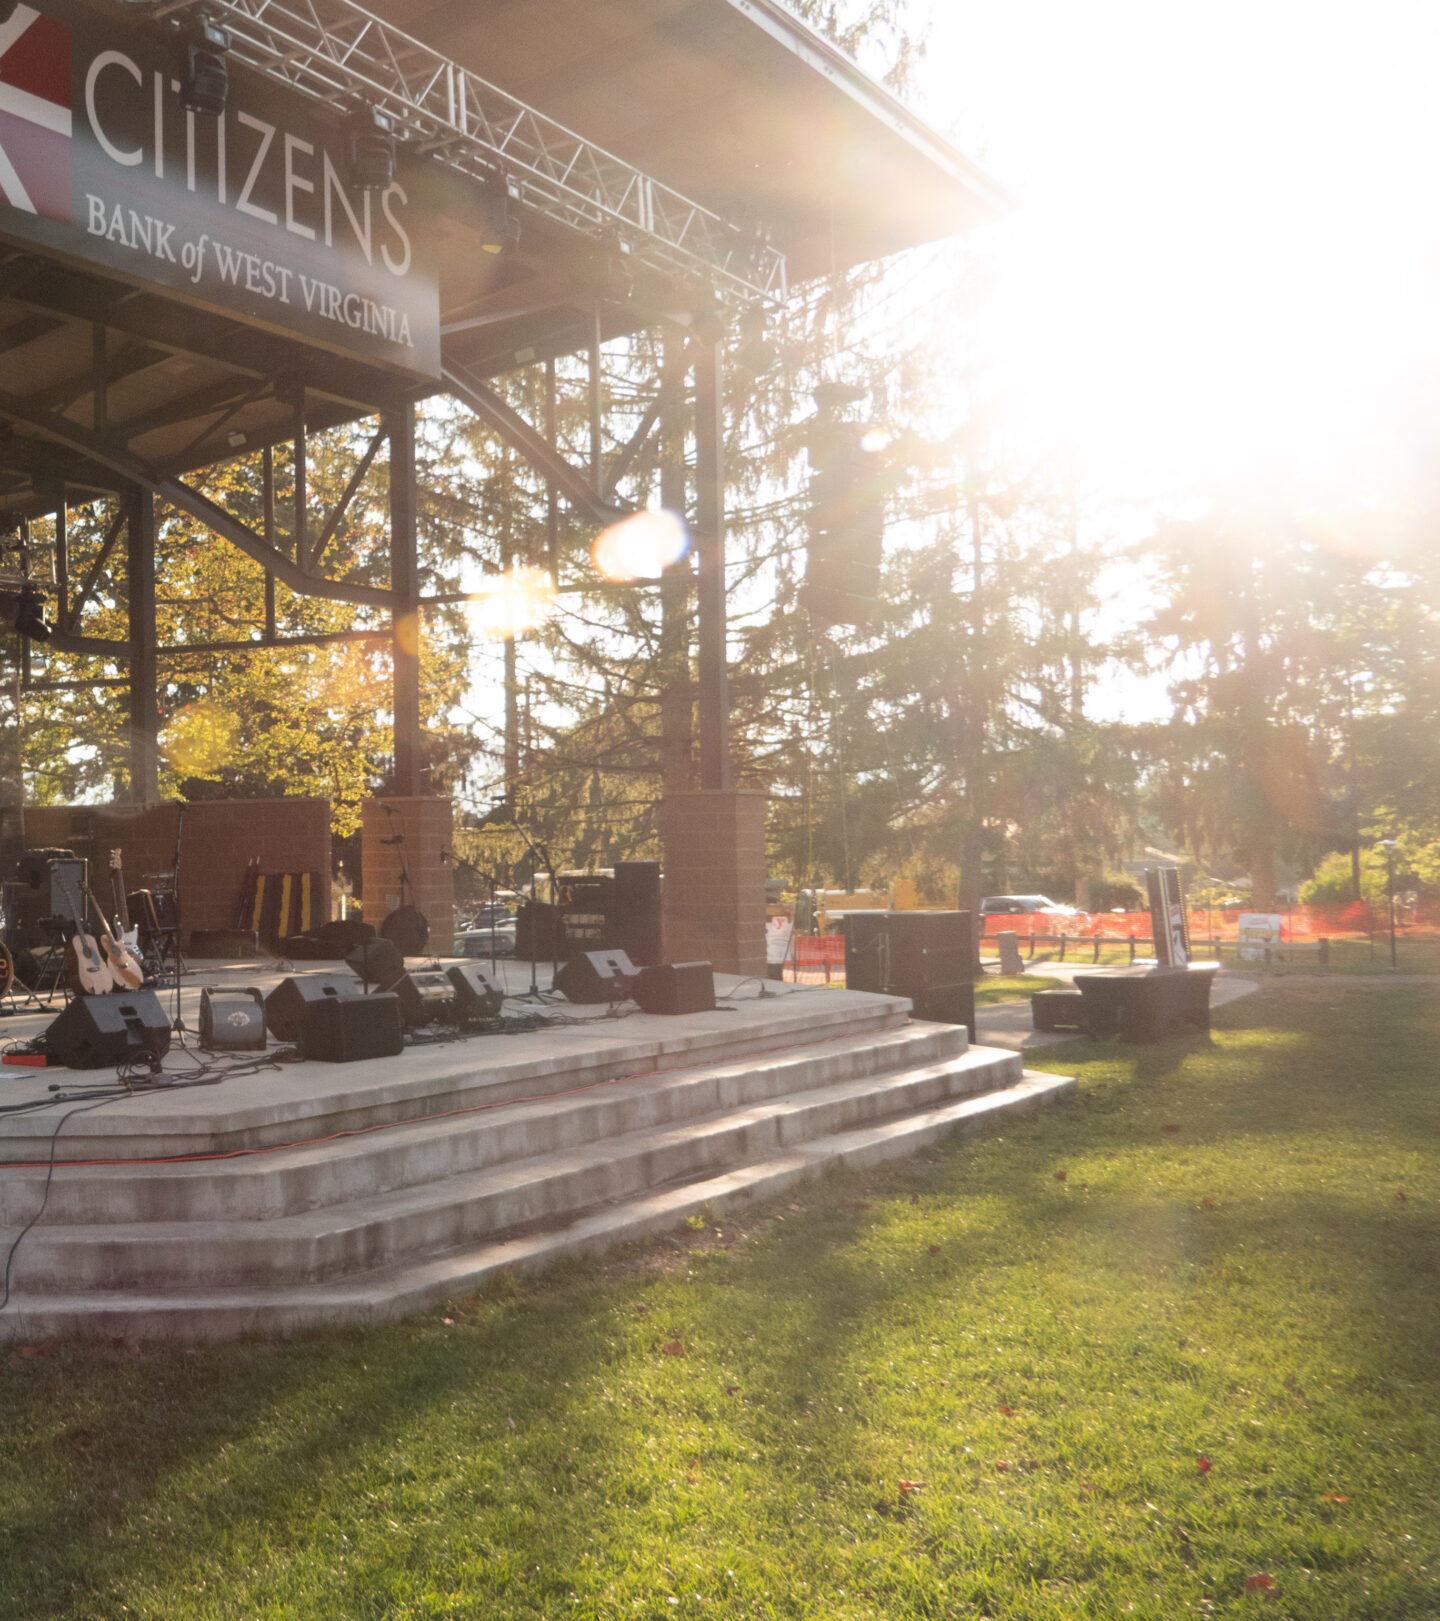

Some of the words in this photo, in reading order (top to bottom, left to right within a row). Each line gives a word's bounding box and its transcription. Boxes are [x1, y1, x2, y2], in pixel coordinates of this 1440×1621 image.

[85, 50, 411, 277] CITIZENS
[86, 194, 176, 263] BANK
[181, 234, 208, 284] of
[213, 242, 293, 304] WEST
[299, 274, 414, 347] VIRGINIA
